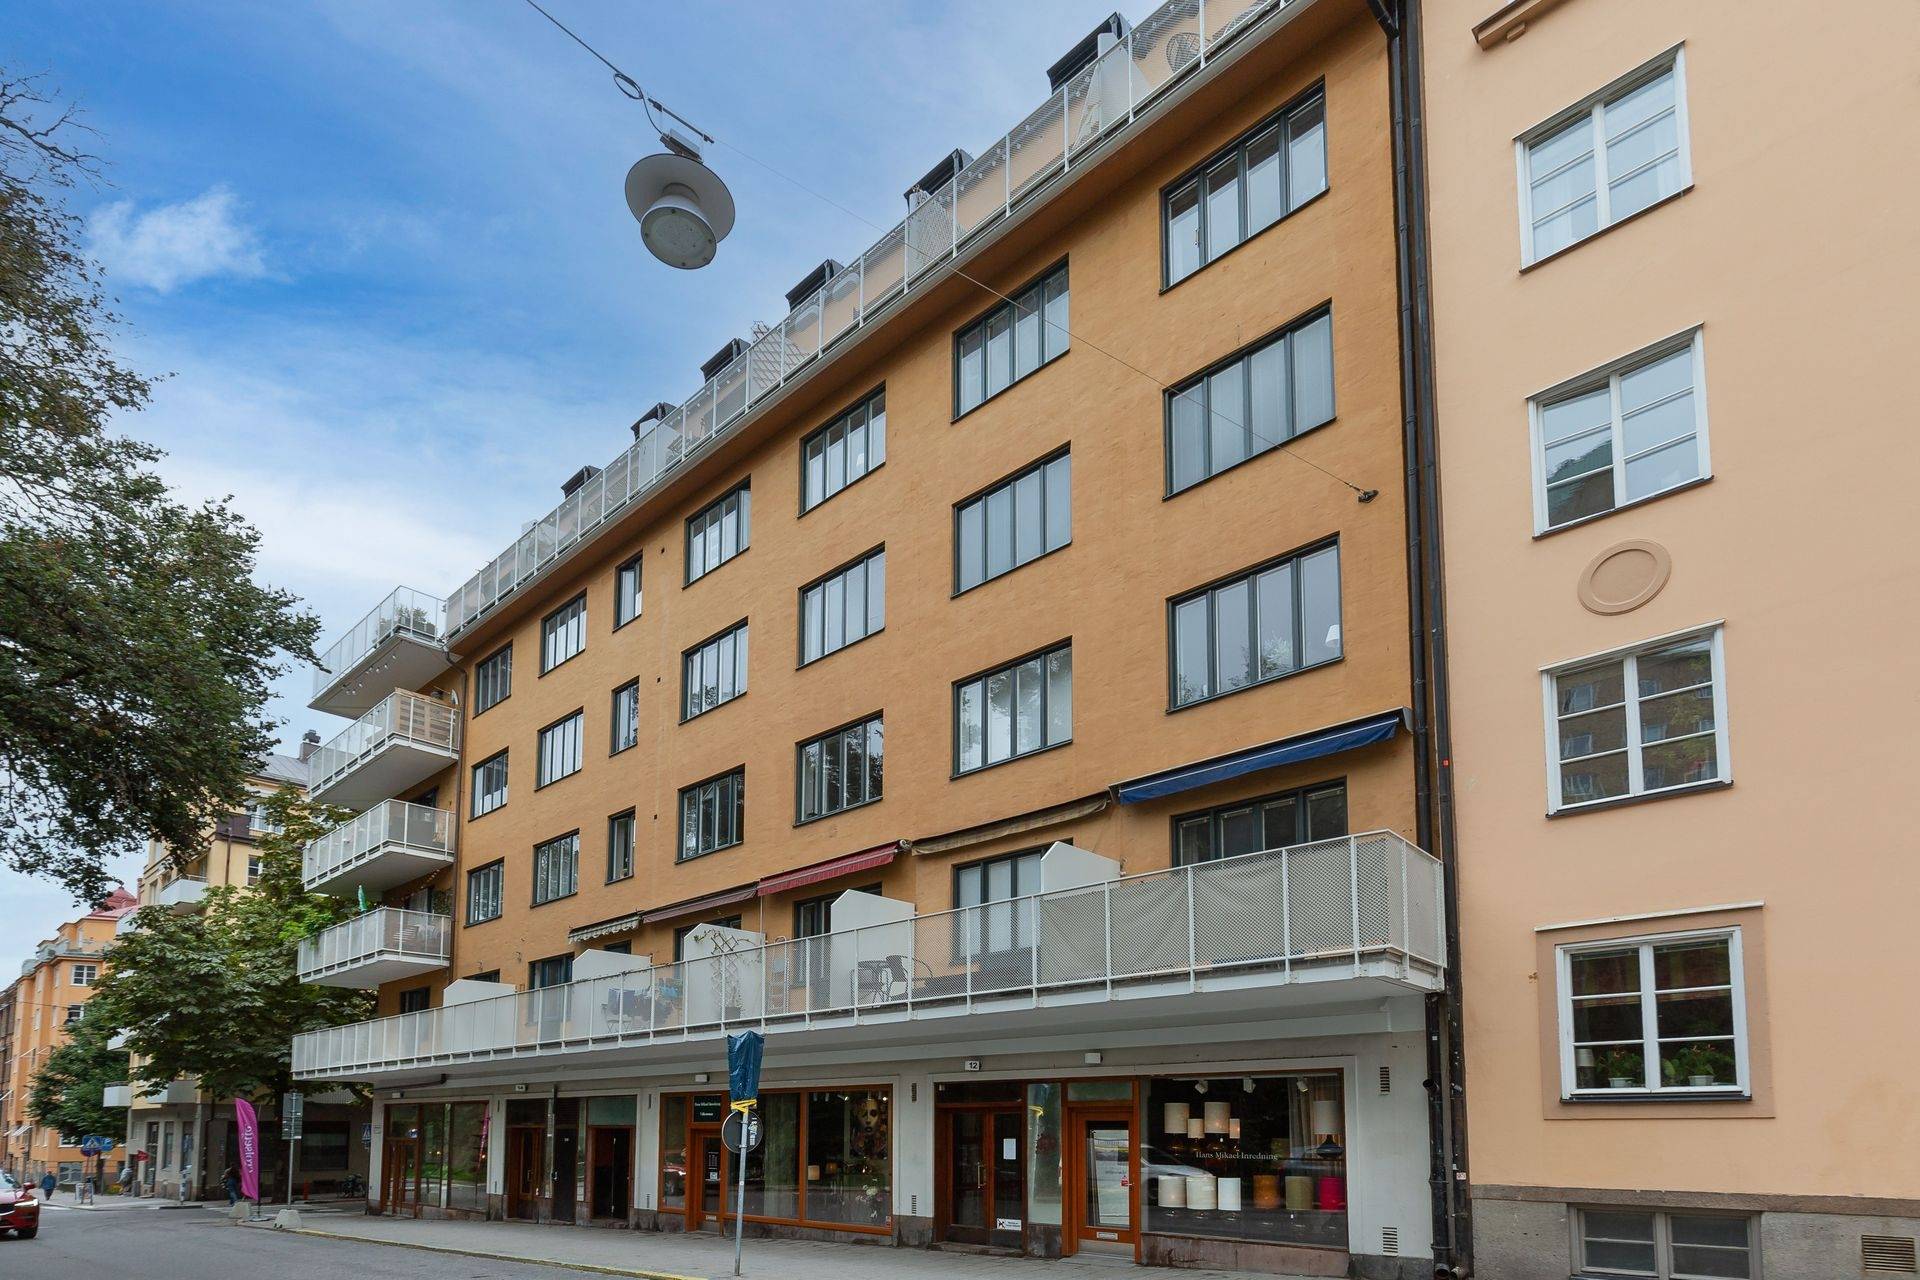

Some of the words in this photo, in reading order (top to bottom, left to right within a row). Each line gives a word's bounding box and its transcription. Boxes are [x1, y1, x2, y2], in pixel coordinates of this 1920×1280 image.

[969, 1061, 978, 1069] 12
[1196, 1151, 1214, 1159] Hans
[1215, 1151, 1240, 1159] Mikael
[1241, 1151, 1278, 1161] Inredning
